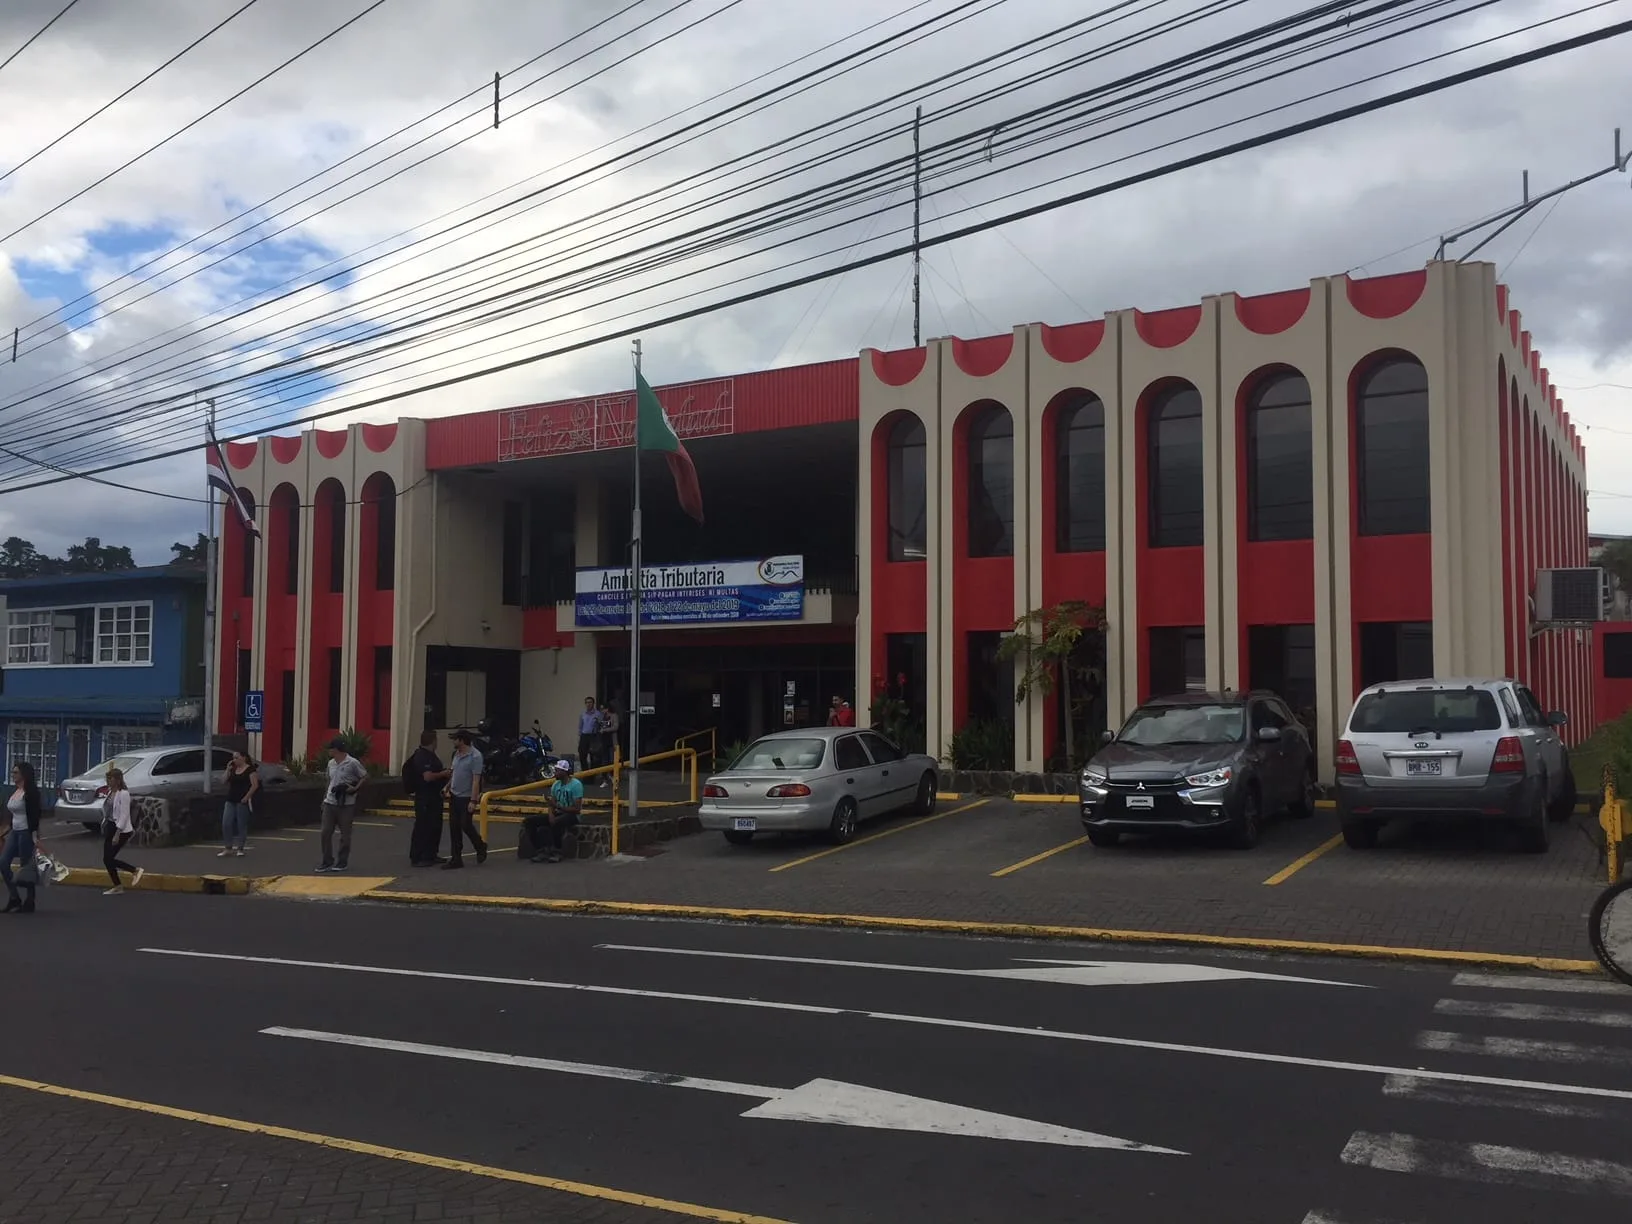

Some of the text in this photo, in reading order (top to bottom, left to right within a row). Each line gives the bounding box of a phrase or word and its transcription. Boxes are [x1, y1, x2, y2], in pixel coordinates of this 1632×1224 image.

[601, 566, 725, 590] Amnitía Tributaria
[677, 588, 705, 597] INTERESES
[717, 587, 739, 596] MULTAS
[721, 598, 740, 610] 2019
